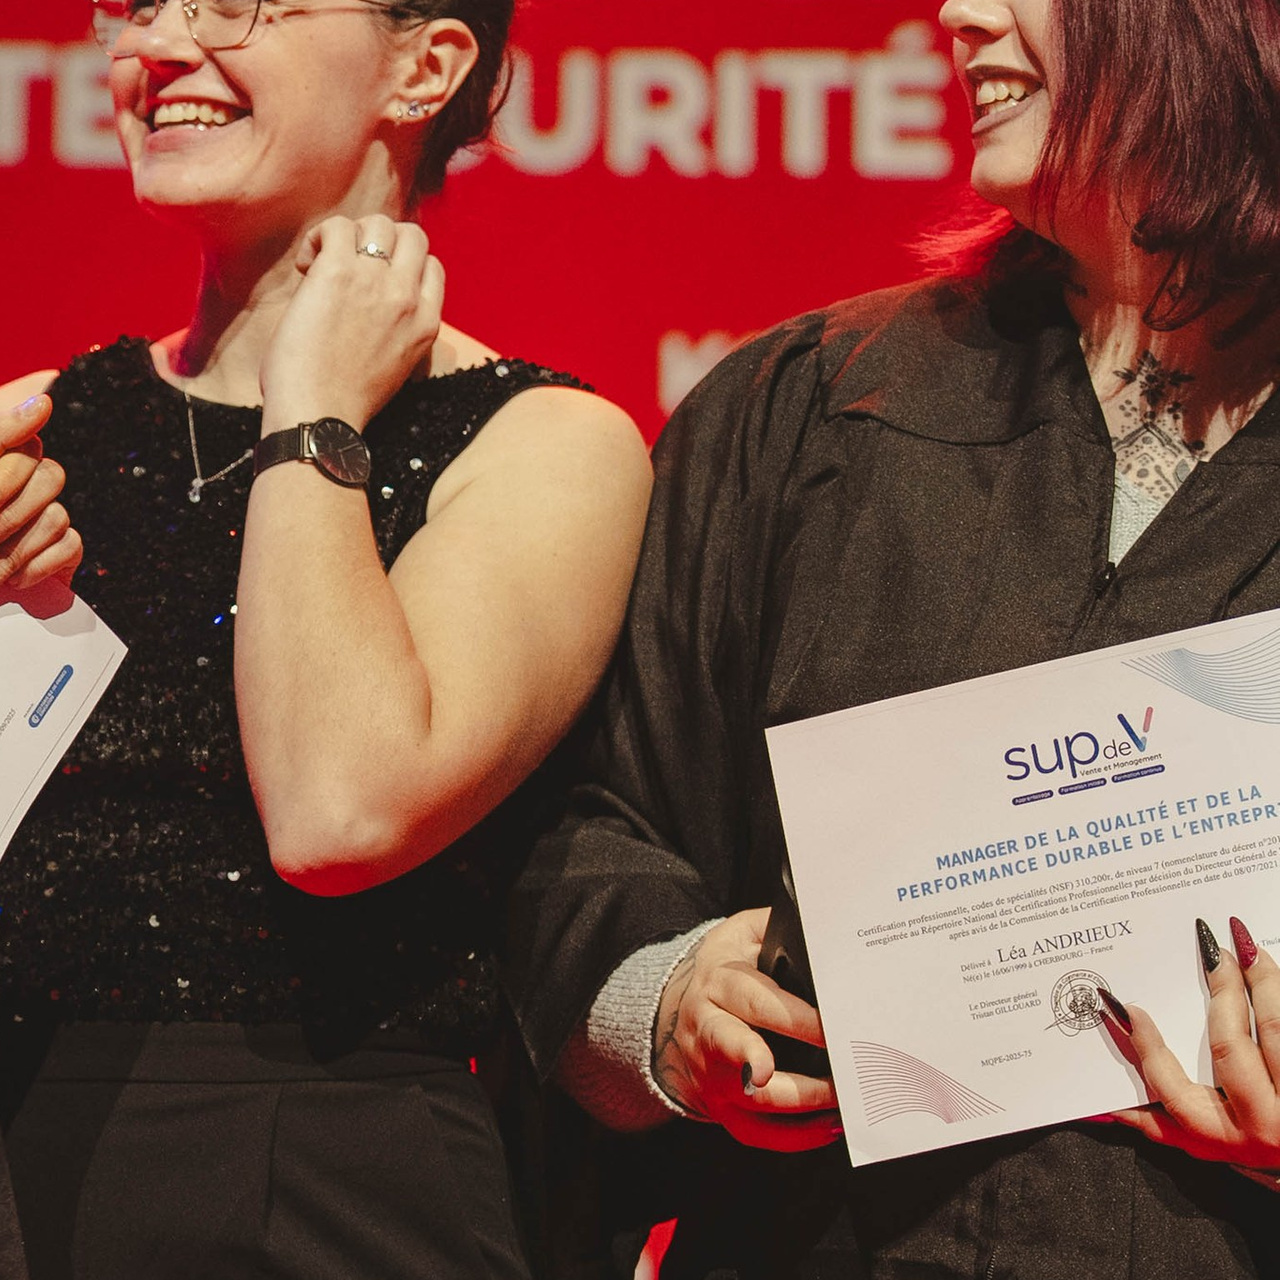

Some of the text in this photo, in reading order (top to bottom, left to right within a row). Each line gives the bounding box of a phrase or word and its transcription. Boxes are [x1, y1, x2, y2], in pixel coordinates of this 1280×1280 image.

[450, 19, 955, 181] URITÉ
[1079, 753, 1163, 777] Vente et Management
[896, 802, 1280, 901] PERFORMANCE DURABLE DE L'ENTREPR
[936, 785, 1261, 870] MANAGER DE LA QUALITÉ ET DE LA
[856, 920, 906, 937] Certification
[907, 906, 969, 927] professionnelle,
[970, 900, 993, 911] codes
[994, 897, 1004, 905] de
[1006, 887, 1047, 904] spécialités
[1048, 881, 1073, 894] (NSF)
[1114, 870, 1124, 878] de
[1125, 864, 1152, 876] niveau
[1153, 861, 1159, 869] 7
[1160, 850, 1217, 869] (nomenclature
[1219, 847, 1230, 855] du
[1231, 841, 1256, 852] décret
[865, 848, 1277, 947] enregistrée au Répertoire National des Certifications Professionnelles par décision du Directeur Général de
[948, 929, 970, 941] après
[971, 924, 986, 934] avis
[988, 922, 998, 930] de
[999, 920, 1007, 928] la
[1008, 909, 1058, 925] Commission
[1059, 906, 1069, 914] de
[1070, 904, 1078, 912] la
[1079, 894, 1129, 909] Certification
[1130, 879, 1190, 898] Professionnelle
[1203, 874, 1220, 882] date
[1221, 870, 1232, 878] du
[960, 960, 985, 972] Délivré
[997, 945, 1027, 962] Léa
[1032, 920, 1131, 955] ANDRIEUX
[962, 971, 983, 984] Né(e)
[982, 970, 990, 979] le
[1032, 949, 1083, 968] CHERBOURG
[1089, 942, 1113, 955] France
[968, 989, 1037, 1011] Le Directeur général
[970, 998, 1041, 1020] Tristan GILLOUARD
